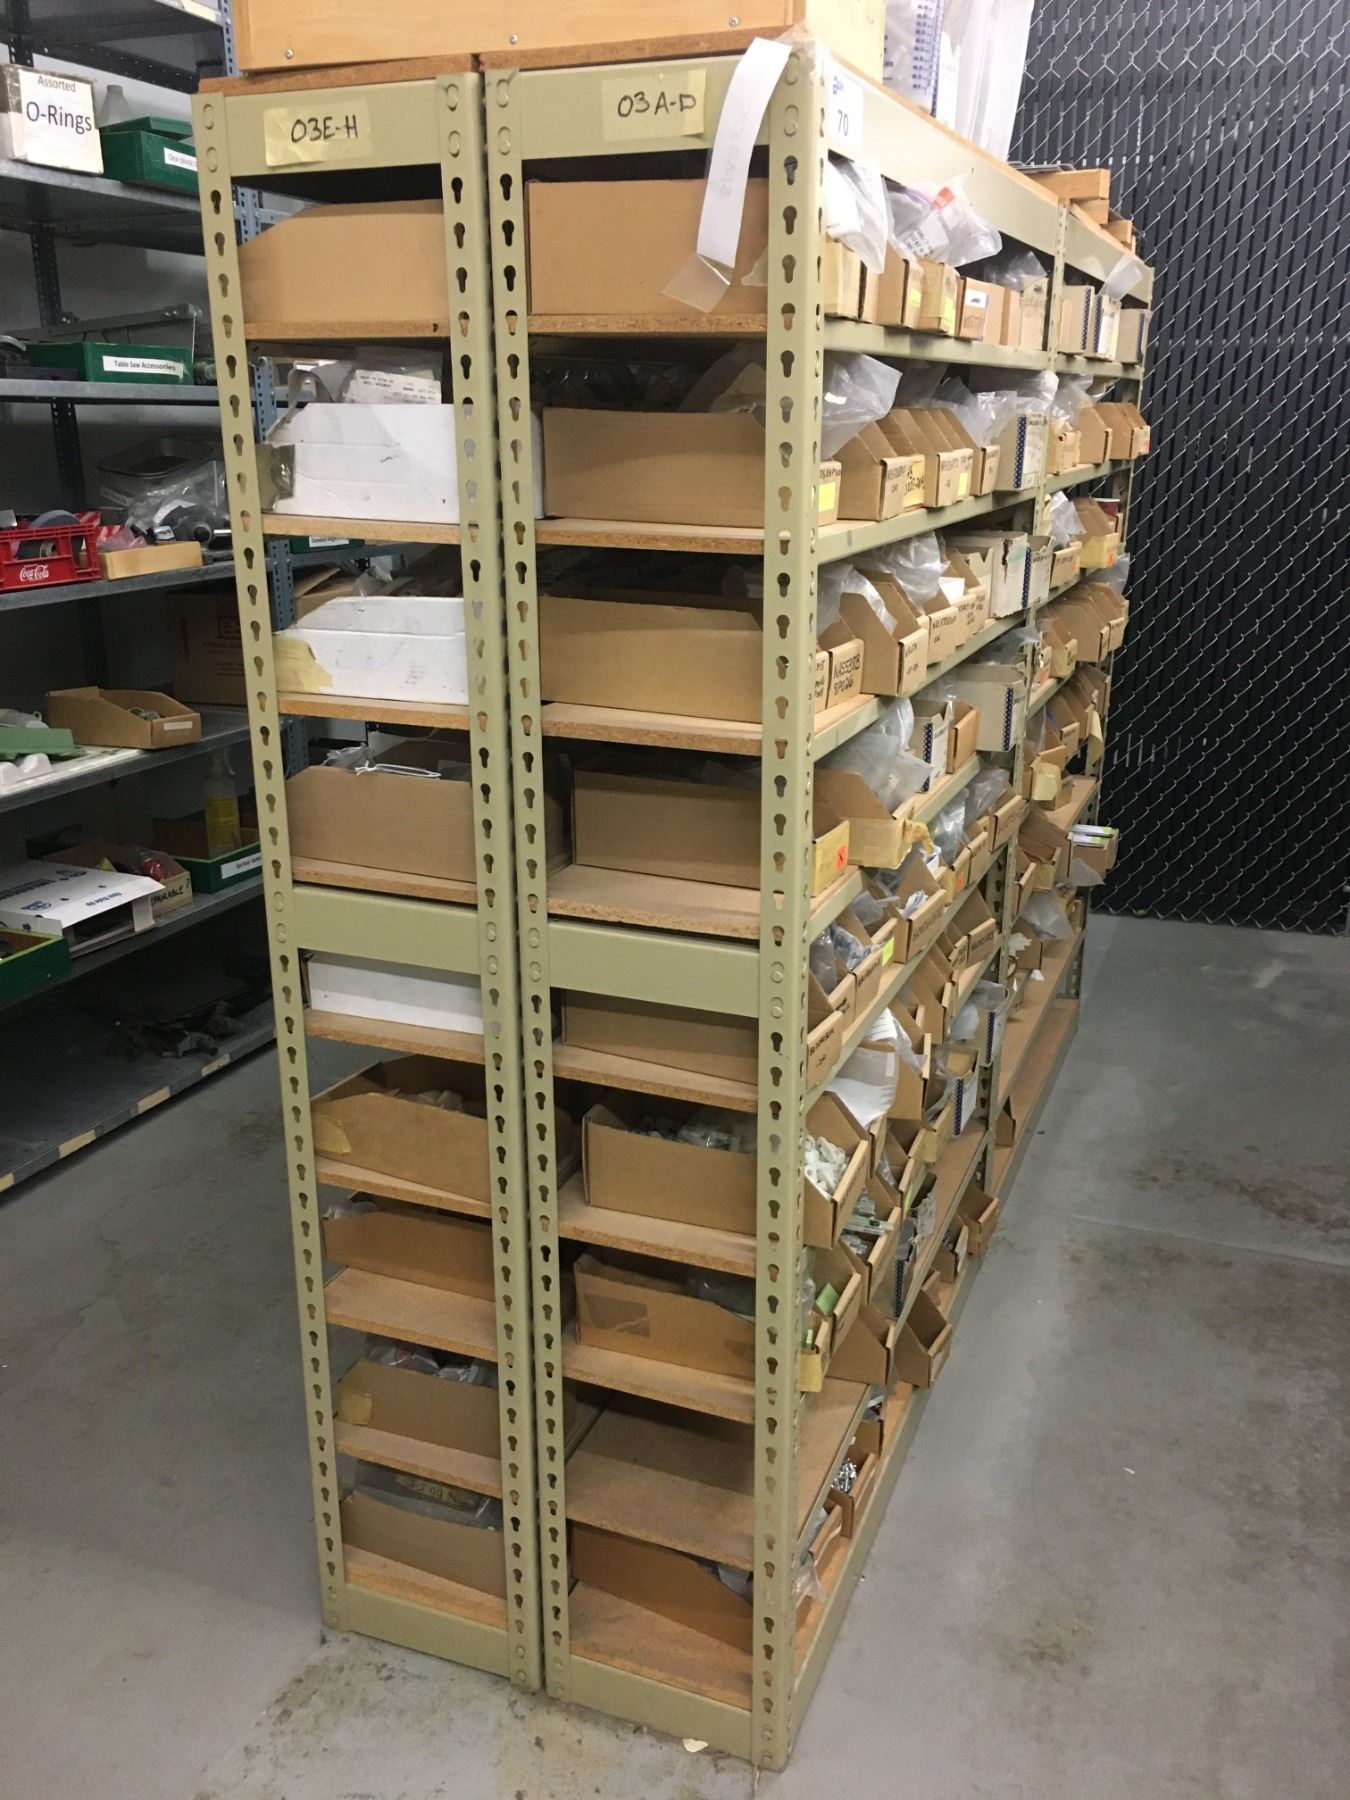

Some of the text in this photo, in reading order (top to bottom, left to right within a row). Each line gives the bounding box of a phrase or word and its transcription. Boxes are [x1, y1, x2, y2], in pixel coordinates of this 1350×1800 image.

[38, 75, 76, 92] Assorted
[26, 101, 92, 135] O-Rings
[290, 114, 359, 144] 03E-H
[836, 110, 849, 136] 70
[114, 360, 176, 371] Table Saw Accessories
